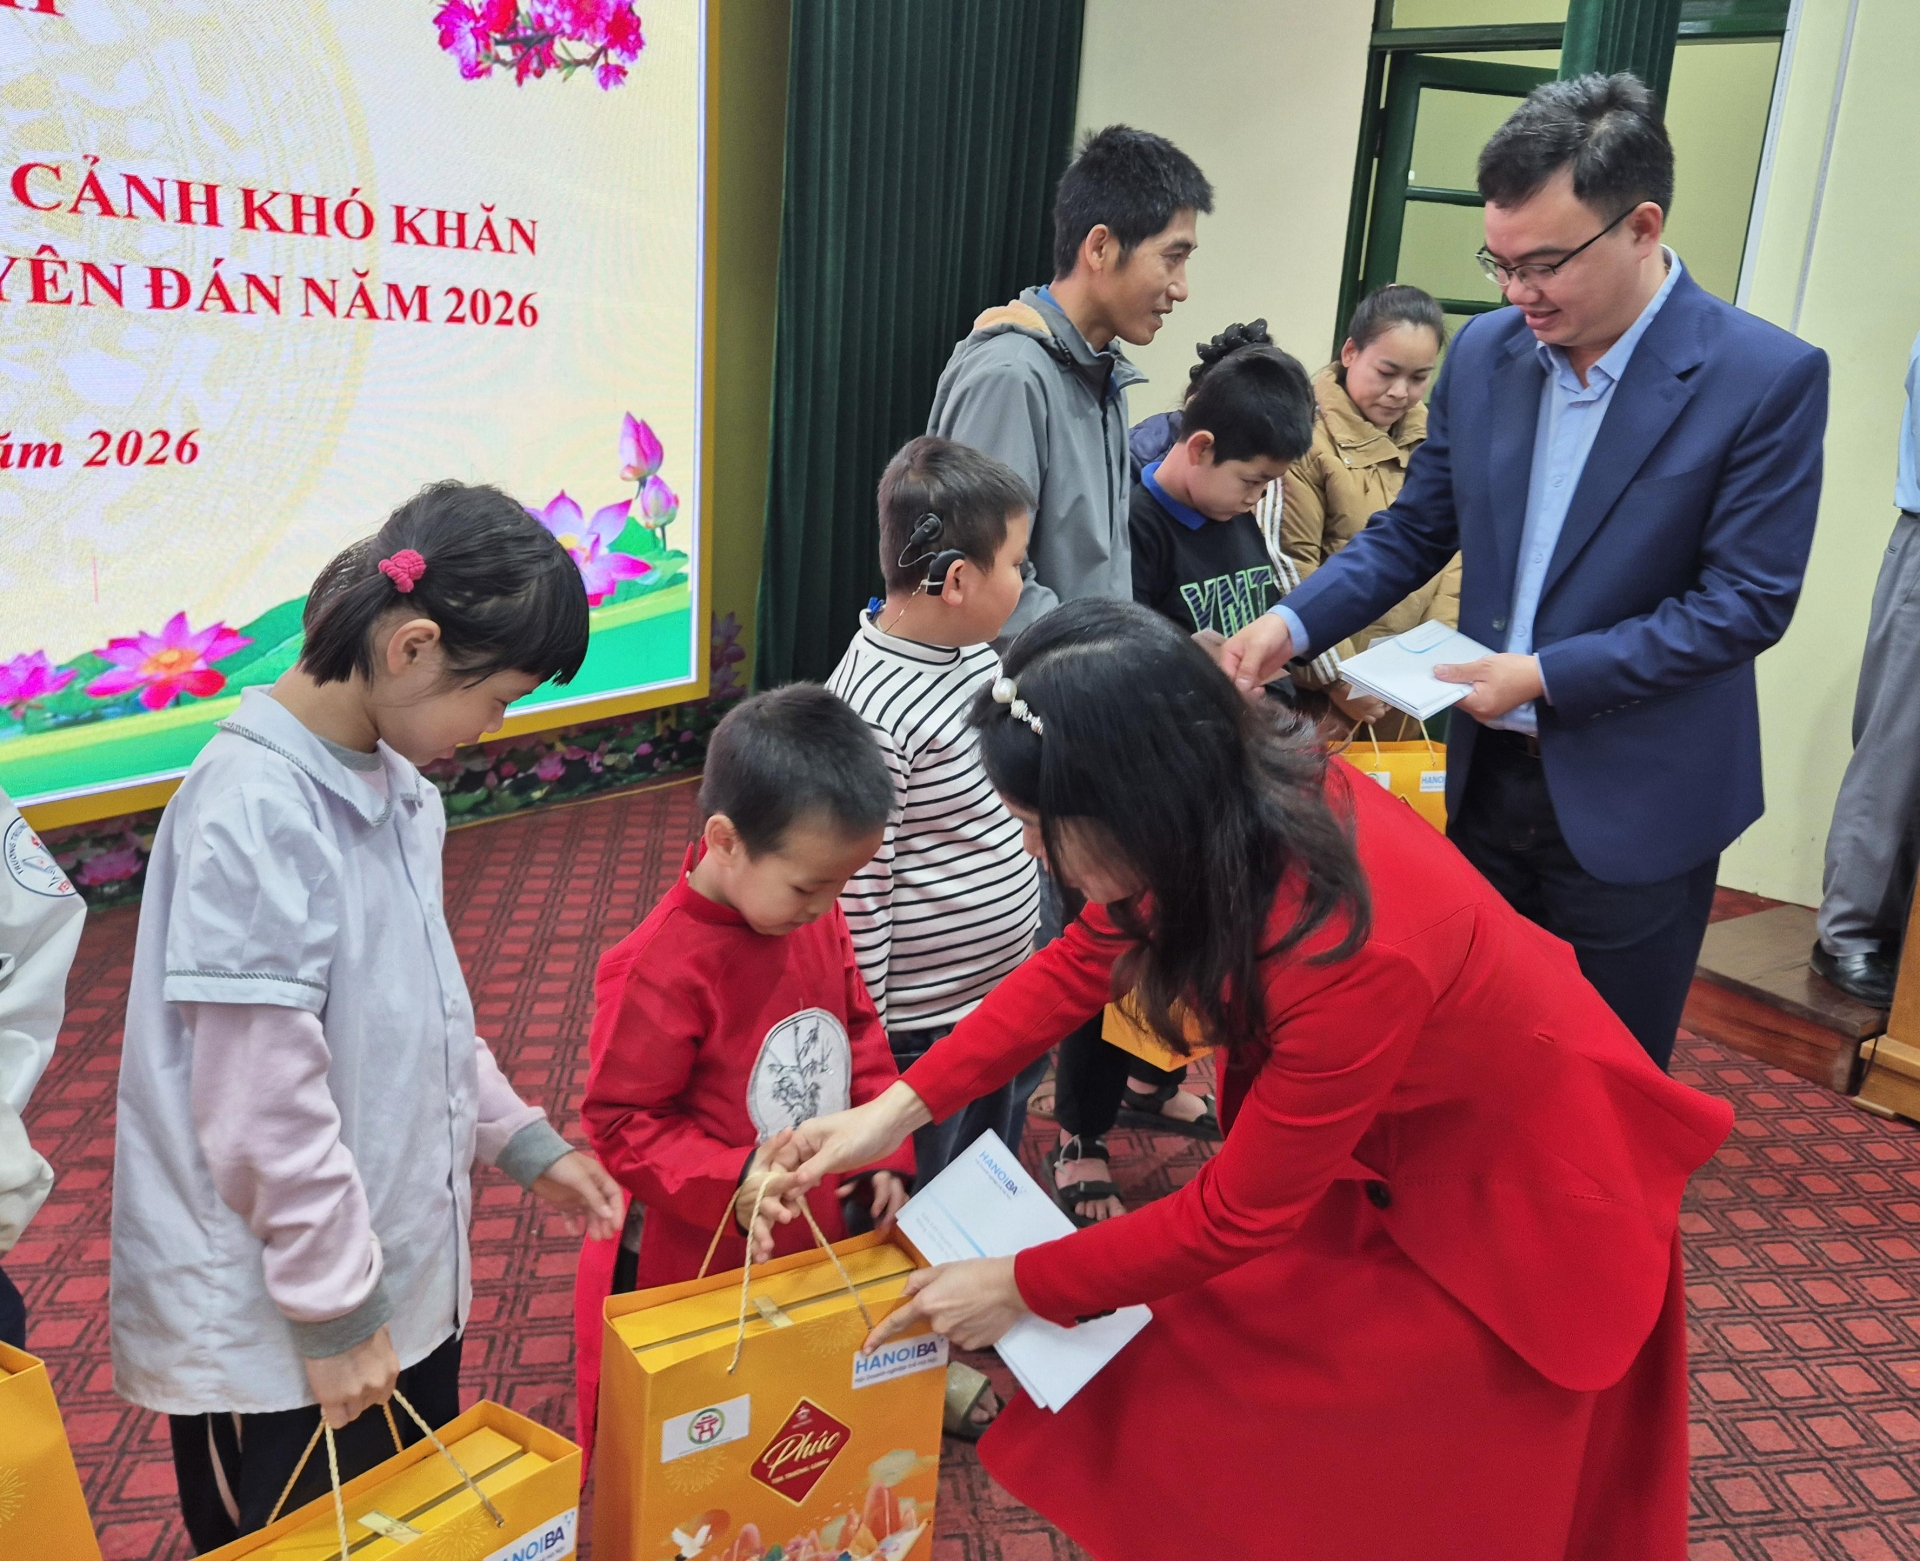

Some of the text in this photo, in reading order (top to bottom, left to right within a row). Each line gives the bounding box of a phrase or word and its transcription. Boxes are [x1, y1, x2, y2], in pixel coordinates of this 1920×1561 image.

[10, 154, 538, 256] CẢNH KHÓ KHĂN
[144, 258, 282, 316] ĐÁN
[300, 268, 432, 324] NĂM
[444, 287, 539, 328] 2026
[82, 428, 200, 468] 2026
[979, 1150, 1018, 1195] HANOIBA
[855, 1341, 938, 1374] HANOIBA
[503, 1526, 564, 1561] NOIBA
